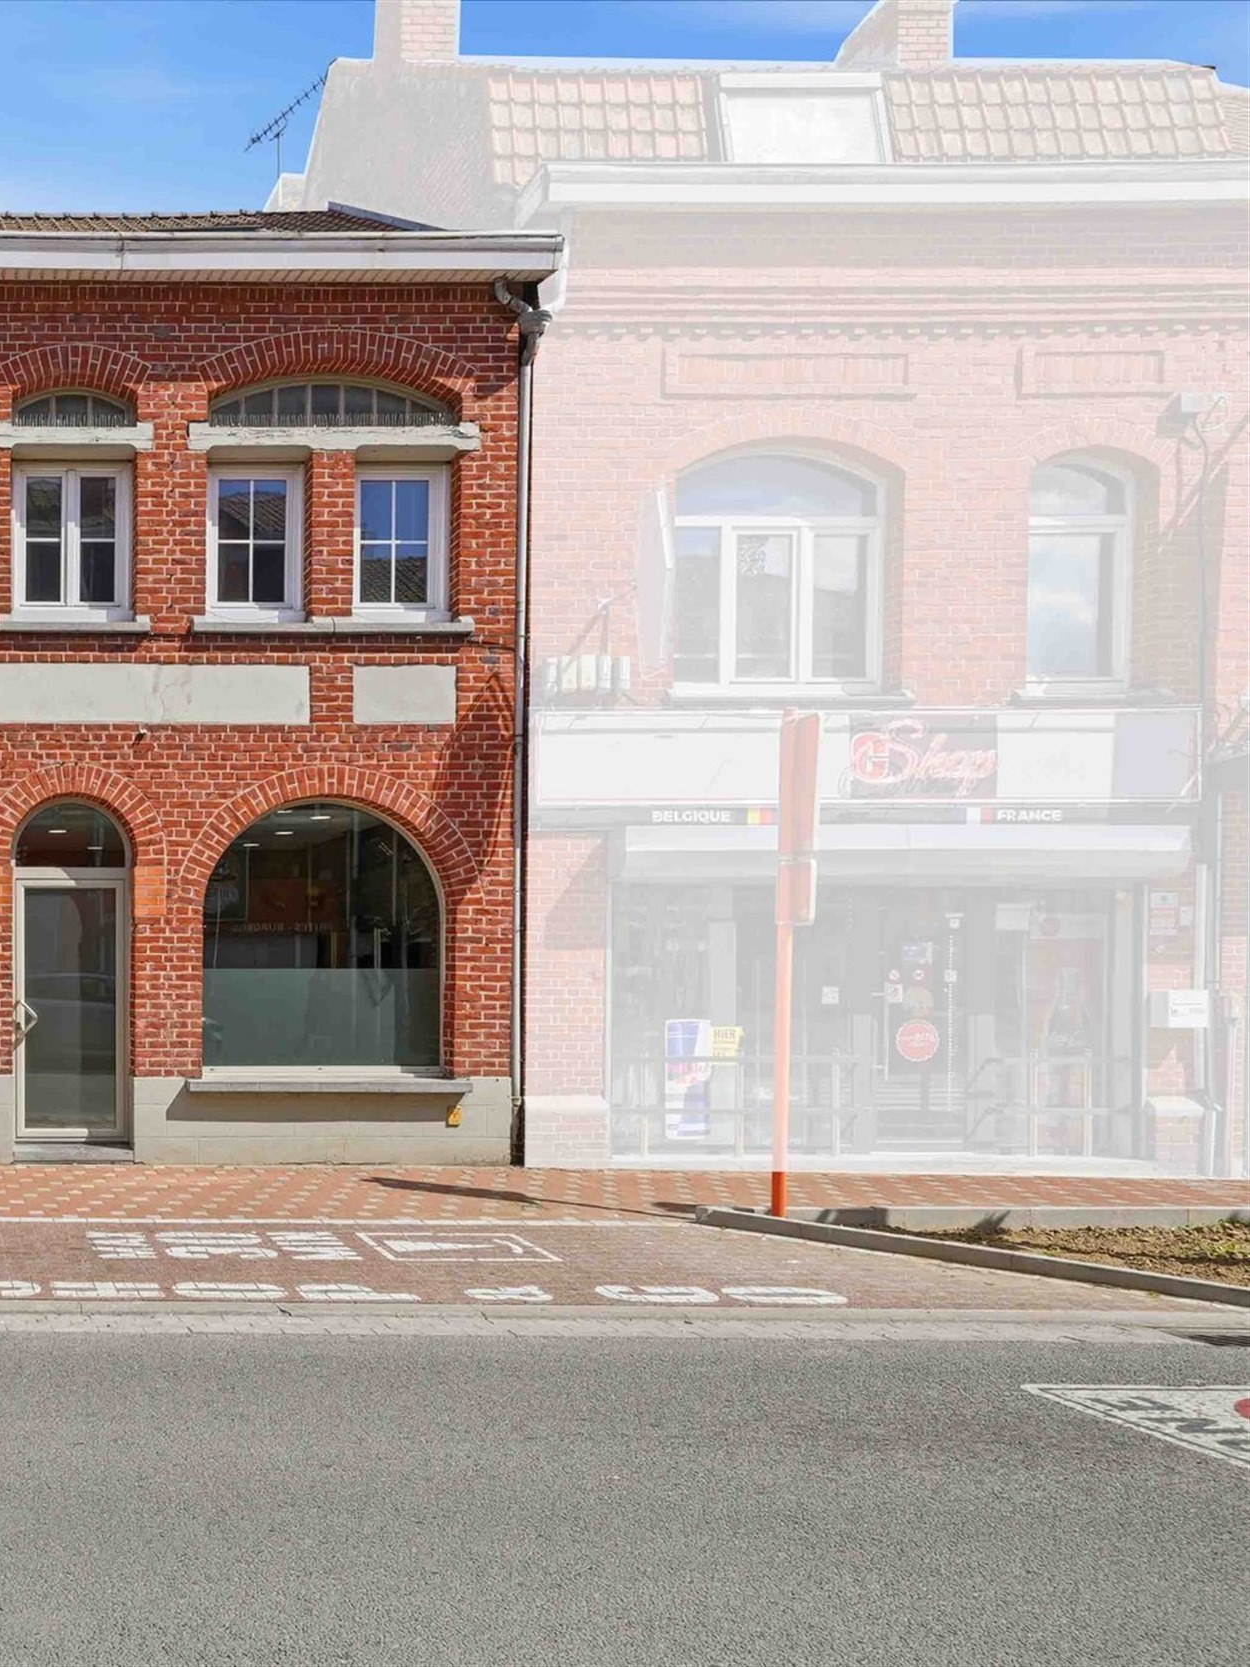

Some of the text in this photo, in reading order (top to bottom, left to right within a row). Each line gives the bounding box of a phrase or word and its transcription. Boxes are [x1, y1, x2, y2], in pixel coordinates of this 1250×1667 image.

[652, 809, 731, 824] BELGIQUE
[996, 808, 1063, 822] FRANCE
[265, 1231, 366, 1261] MIN
[463, 1285, 555, 1302] &
[594, 1285, 849, 1305] GO
